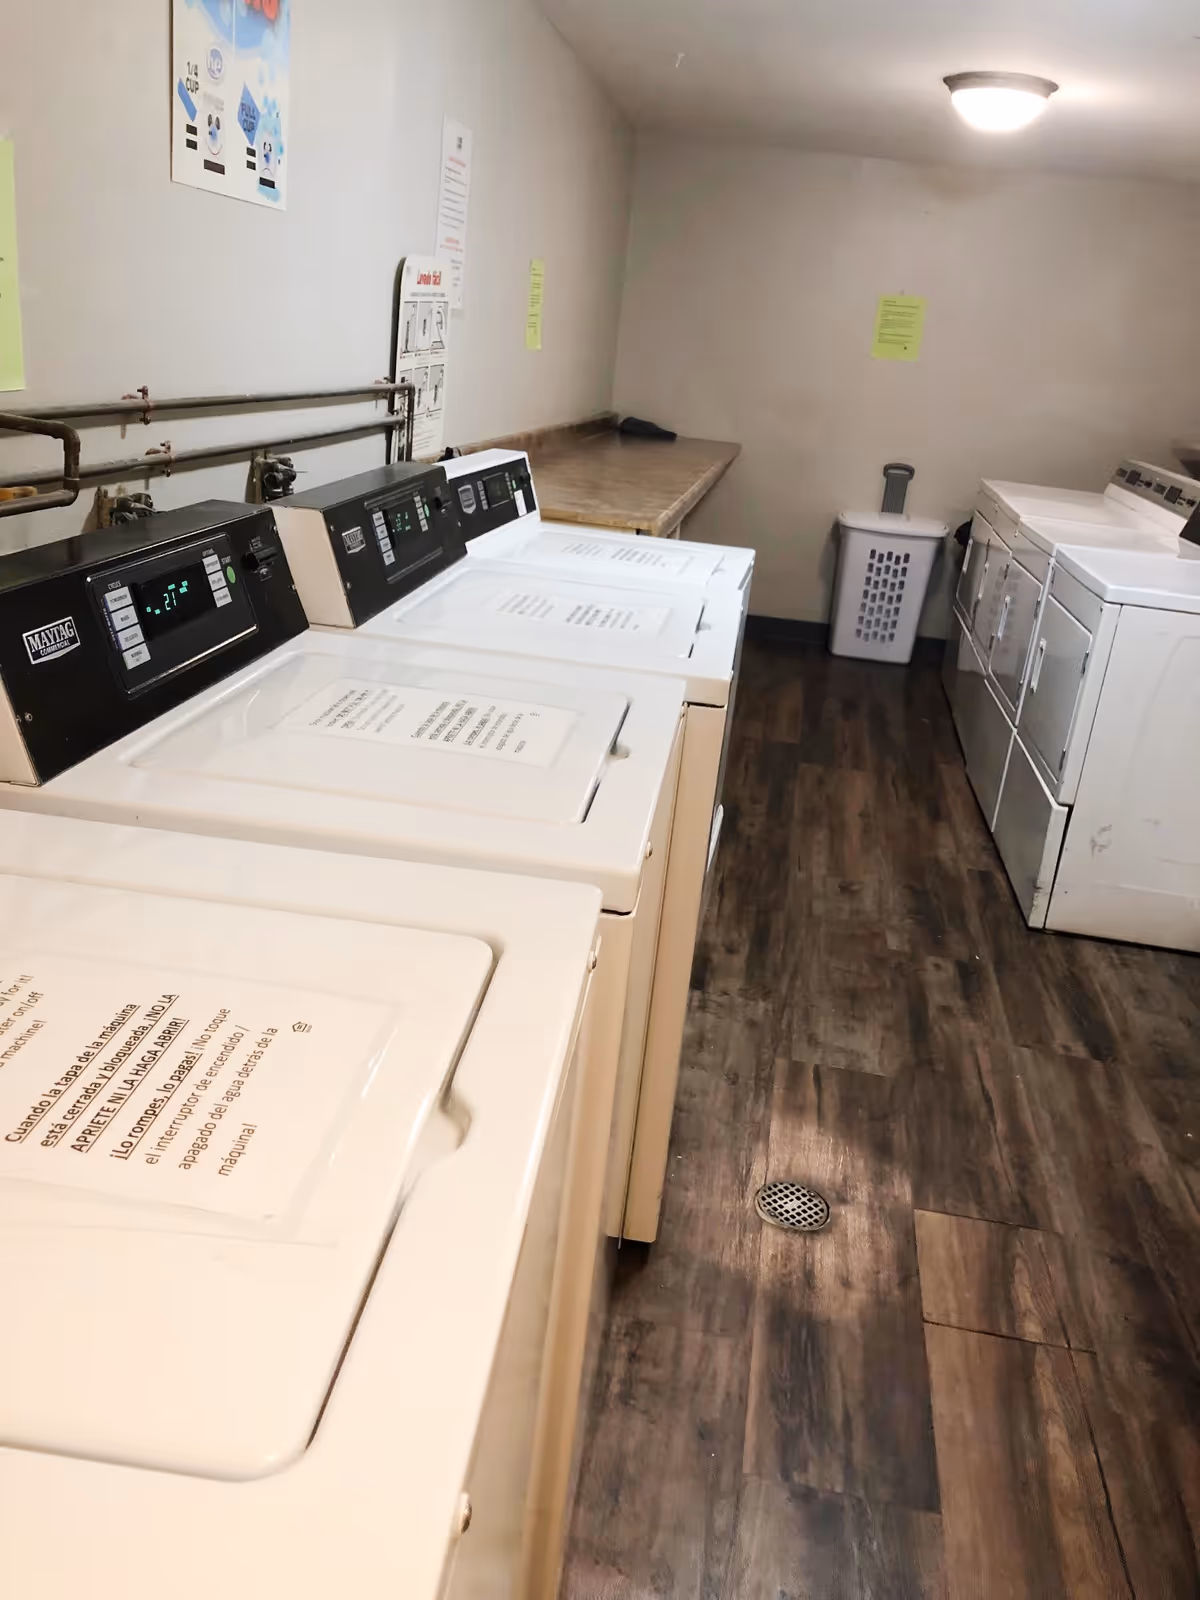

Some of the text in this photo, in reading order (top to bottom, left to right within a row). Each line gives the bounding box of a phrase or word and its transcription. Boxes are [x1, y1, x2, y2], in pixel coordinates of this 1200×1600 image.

[186, 76, 199, 94] CUP
[187, 61, 198, 78] 1/4
[241, 102, 256, 121] FULL
[243, 118, 255, 133] CUP
[28, 621, 75, 652] MAYTAG
[40, 639, 71, 656] COMMERCIAL
[0, 974, 34, 996] for it!
[13, 991, 44, 1017] on/off
[1, 1019, 47, 1060] machine!
[205, 1031, 244, 1077] encendido
[4, 1003, 137, 1143] Cuando la tapa de la máquina
[40, 1121, 67, 1148] está
[63, 1081, 101, 1122] cerrada
[99, 1025, 153, 1074] bloqueada,
[143, 1004, 165, 1023] ¡NO
[162, 993, 177, 1005] LA
[70, 1017, 187, 1153] APRIETE NI LA HAGA ABRIR!
[109, 1008, 231, 1161] ¡Lo rompes, lo pagas! ¡No toque
[193, 1078, 212, 1091] de
[178, 1027, 278, 1170] apagado del agua detrás de la
[150, 1092, 201, 1152] interruptor
[145, 1152, 161, 1165] el
[218, 1122, 258, 1177] máquina!
